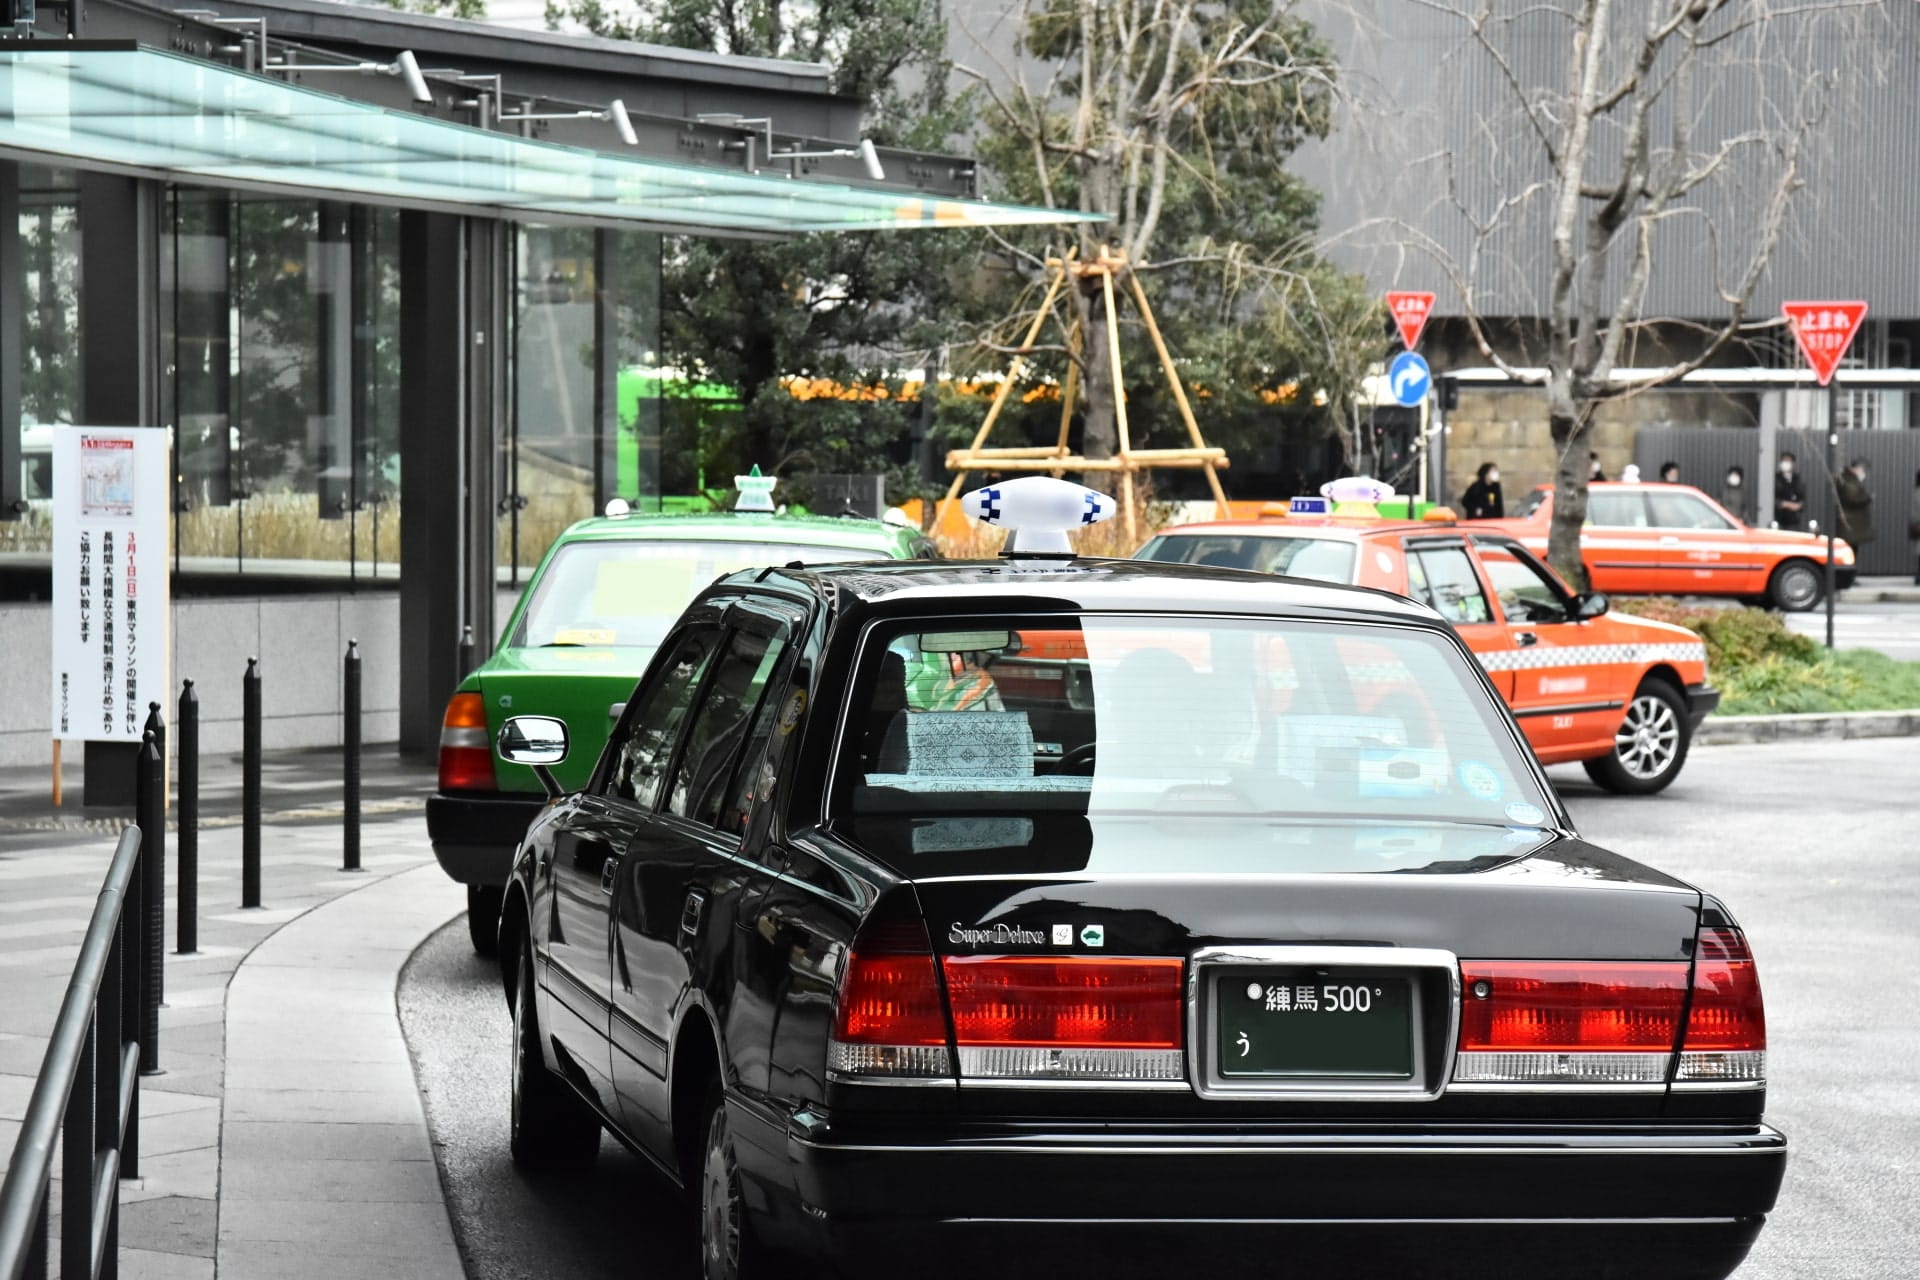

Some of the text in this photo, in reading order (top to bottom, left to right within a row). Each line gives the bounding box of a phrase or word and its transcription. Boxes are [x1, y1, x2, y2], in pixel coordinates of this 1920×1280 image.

[1397, 299, 1426, 312] 止まれ
[1801, 310, 1851, 330] 止まれ
[1807, 333, 1844, 350] STOP
[949, 922, 1045, 948] Super Deluxe
[1236, 1031, 1250, 1057] う
